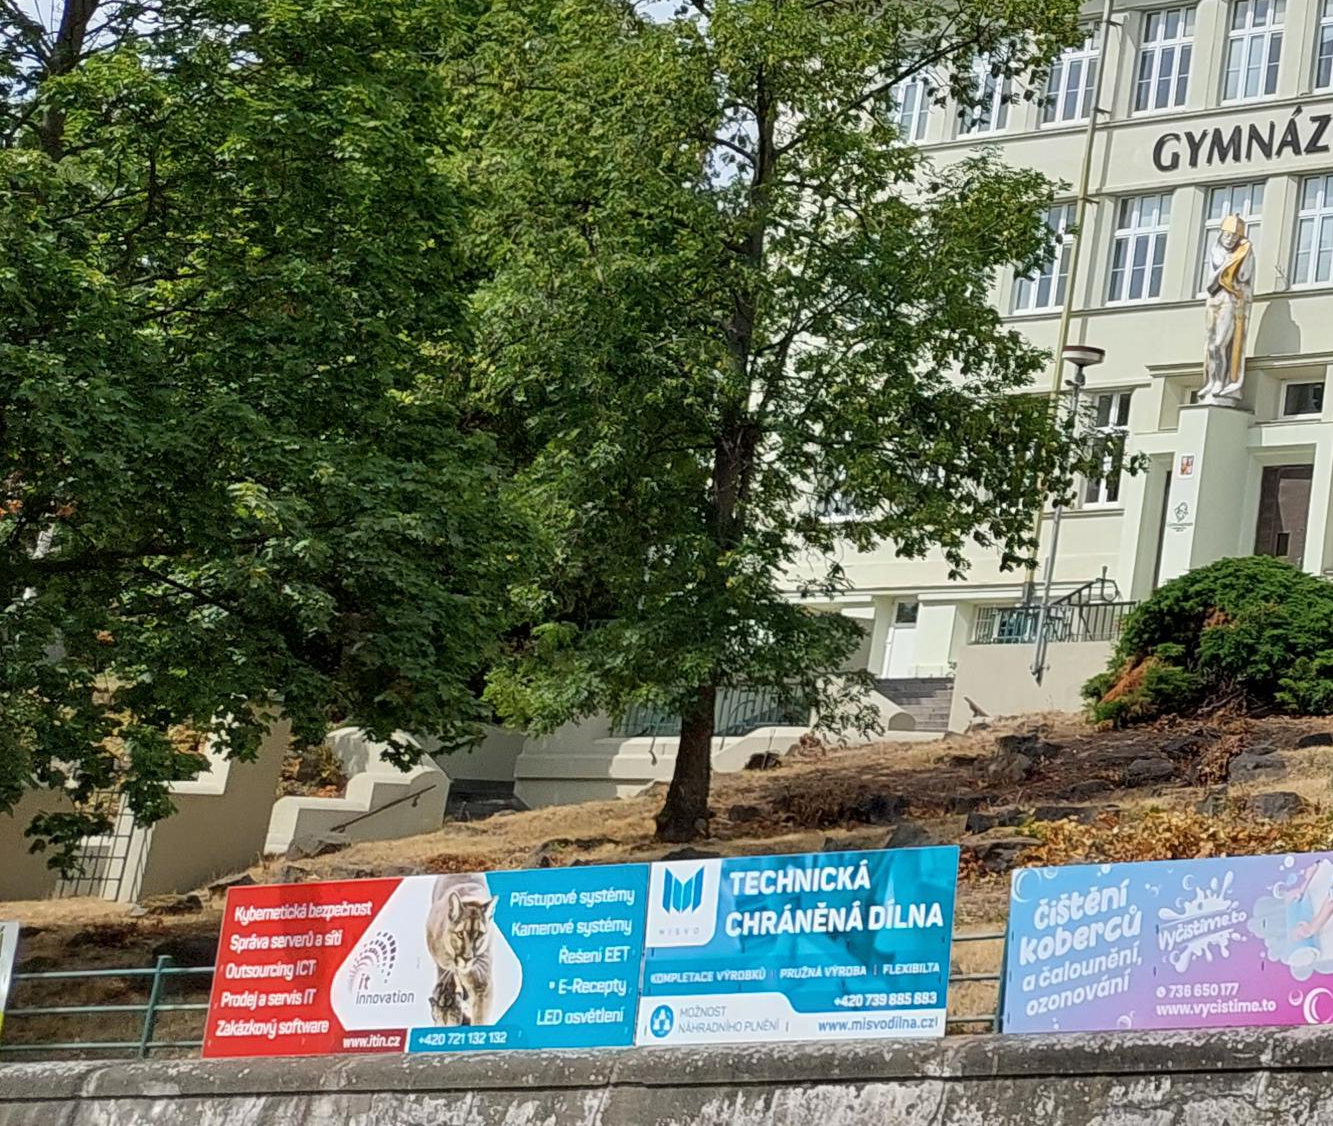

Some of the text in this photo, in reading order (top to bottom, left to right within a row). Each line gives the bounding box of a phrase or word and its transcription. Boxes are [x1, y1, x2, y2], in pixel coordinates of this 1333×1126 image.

[731, 860, 872, 897] TECHNICKÁ
[510, 887, 636, 909] Přístupové systémy
[1034, 878, 1131, 931] čištění
[234, 901, 373, 926] Kybernetická bezpečnost
[725, 898, 945, 938] CHRÁNĚNÁ DÍLNA
[512, 917, 633, 938] Kamerové systémy
[1020, 905, 1143, 967] koberců
[230, 930, 343, 954] Správa serverů a sítí
[559, 945, 631, 965] Řešení EET
[226, 961, 317, 981] Outsourcing ICT
[651, 966, 767, 985] KOMPLETACE VÝROBKŮ
[780, 964, 867, 980] PRUŽNÁ VÝROBA
[883, 963, 940, 976] FLEXIBILTA
[1023, 940, 1143, 993] a čalounění,
[359, 974, 371, 990] it
[559, 978, 627, 998] E-Recepty
[1168, 983, 1240, 1000] 738 650 177
[221, 989, 317, 1011] Prodej a servis IT
[356, 991, 415, 1005] innovation
[834, 995, 864, 1008] +420
[865, 995, 888, 1007] 739
[1027, 969, 1132, 1017] ozonování
[537, 1007, 625, 1026] LED osvětlení
[680, 1005, 727, 1019] MOŽNOST
[1156, 999, 1277, 1019] www.vycistime.to
[215, 1019, 330, 1040] Zakázkový software
[679, 1019, 780, 1034] NÁHRADNÍHO PLNĚNÍ
[818, 1015, 935, 1033] www.misvodilna.cz
[343, 1034, 402, 1049] www.itin.cz
[419, 1032, 508, 1046] +420 721 132 132
